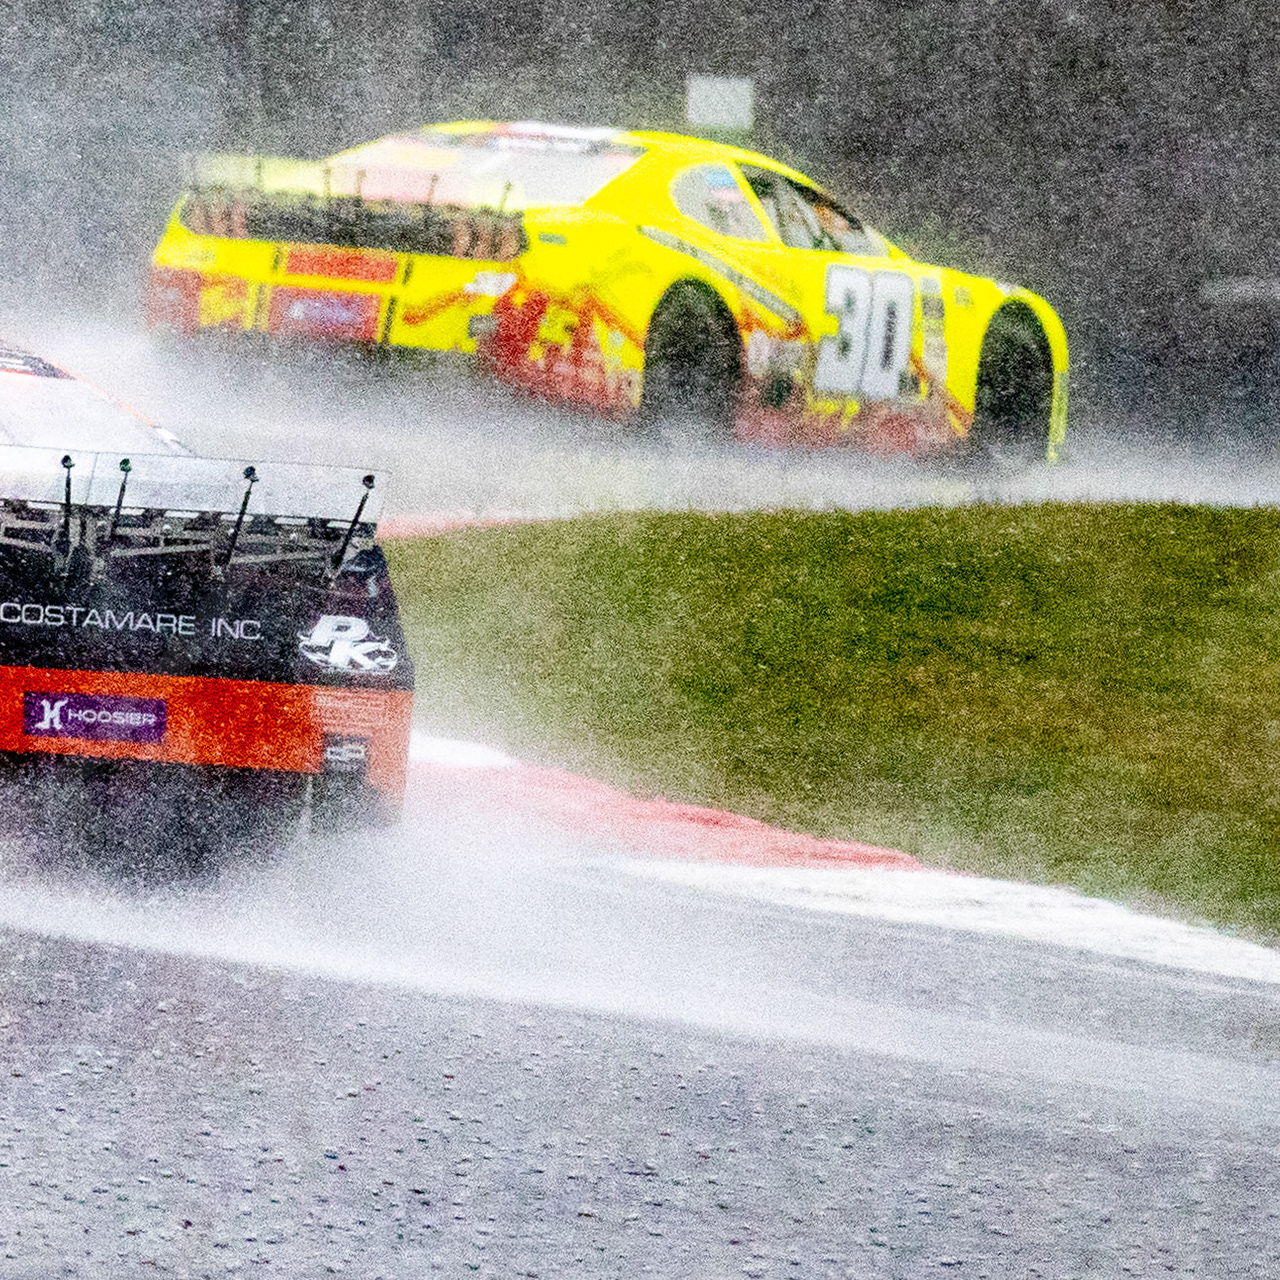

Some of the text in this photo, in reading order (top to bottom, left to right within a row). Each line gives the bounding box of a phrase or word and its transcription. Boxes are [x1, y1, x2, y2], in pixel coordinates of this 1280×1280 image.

[813, 266, 913, 400] 30
[0, 602, 196, 635] COSTAMARE
[68, 709, 157, 726] HOOSIER
